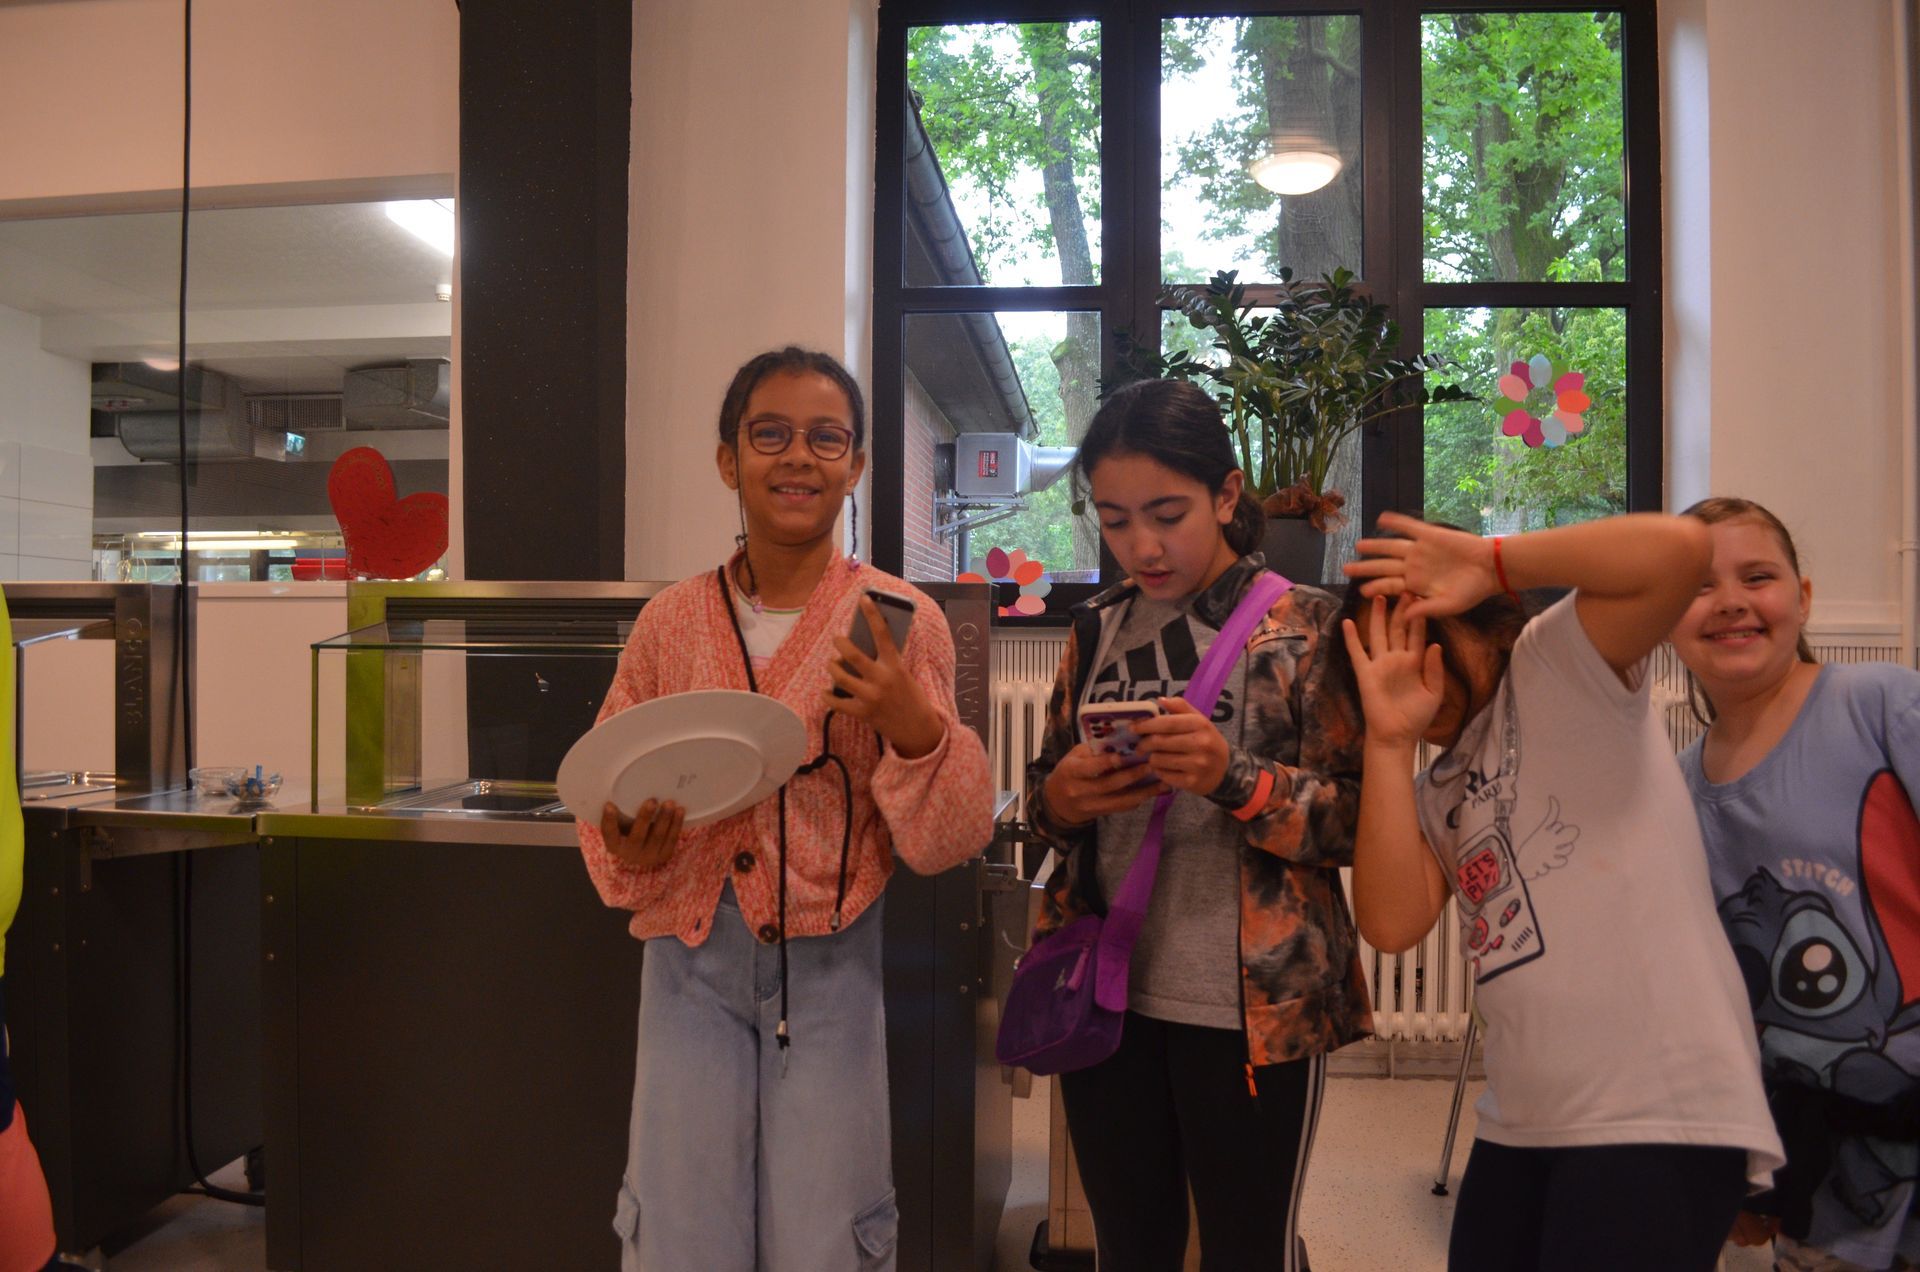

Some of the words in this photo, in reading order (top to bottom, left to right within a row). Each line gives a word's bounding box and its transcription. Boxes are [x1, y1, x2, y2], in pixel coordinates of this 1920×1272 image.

[124, 617, 143, 725] BLANCO
[1088, 680, 1234, 723] dids
[1780, 857, 1855, 896] STITCH
